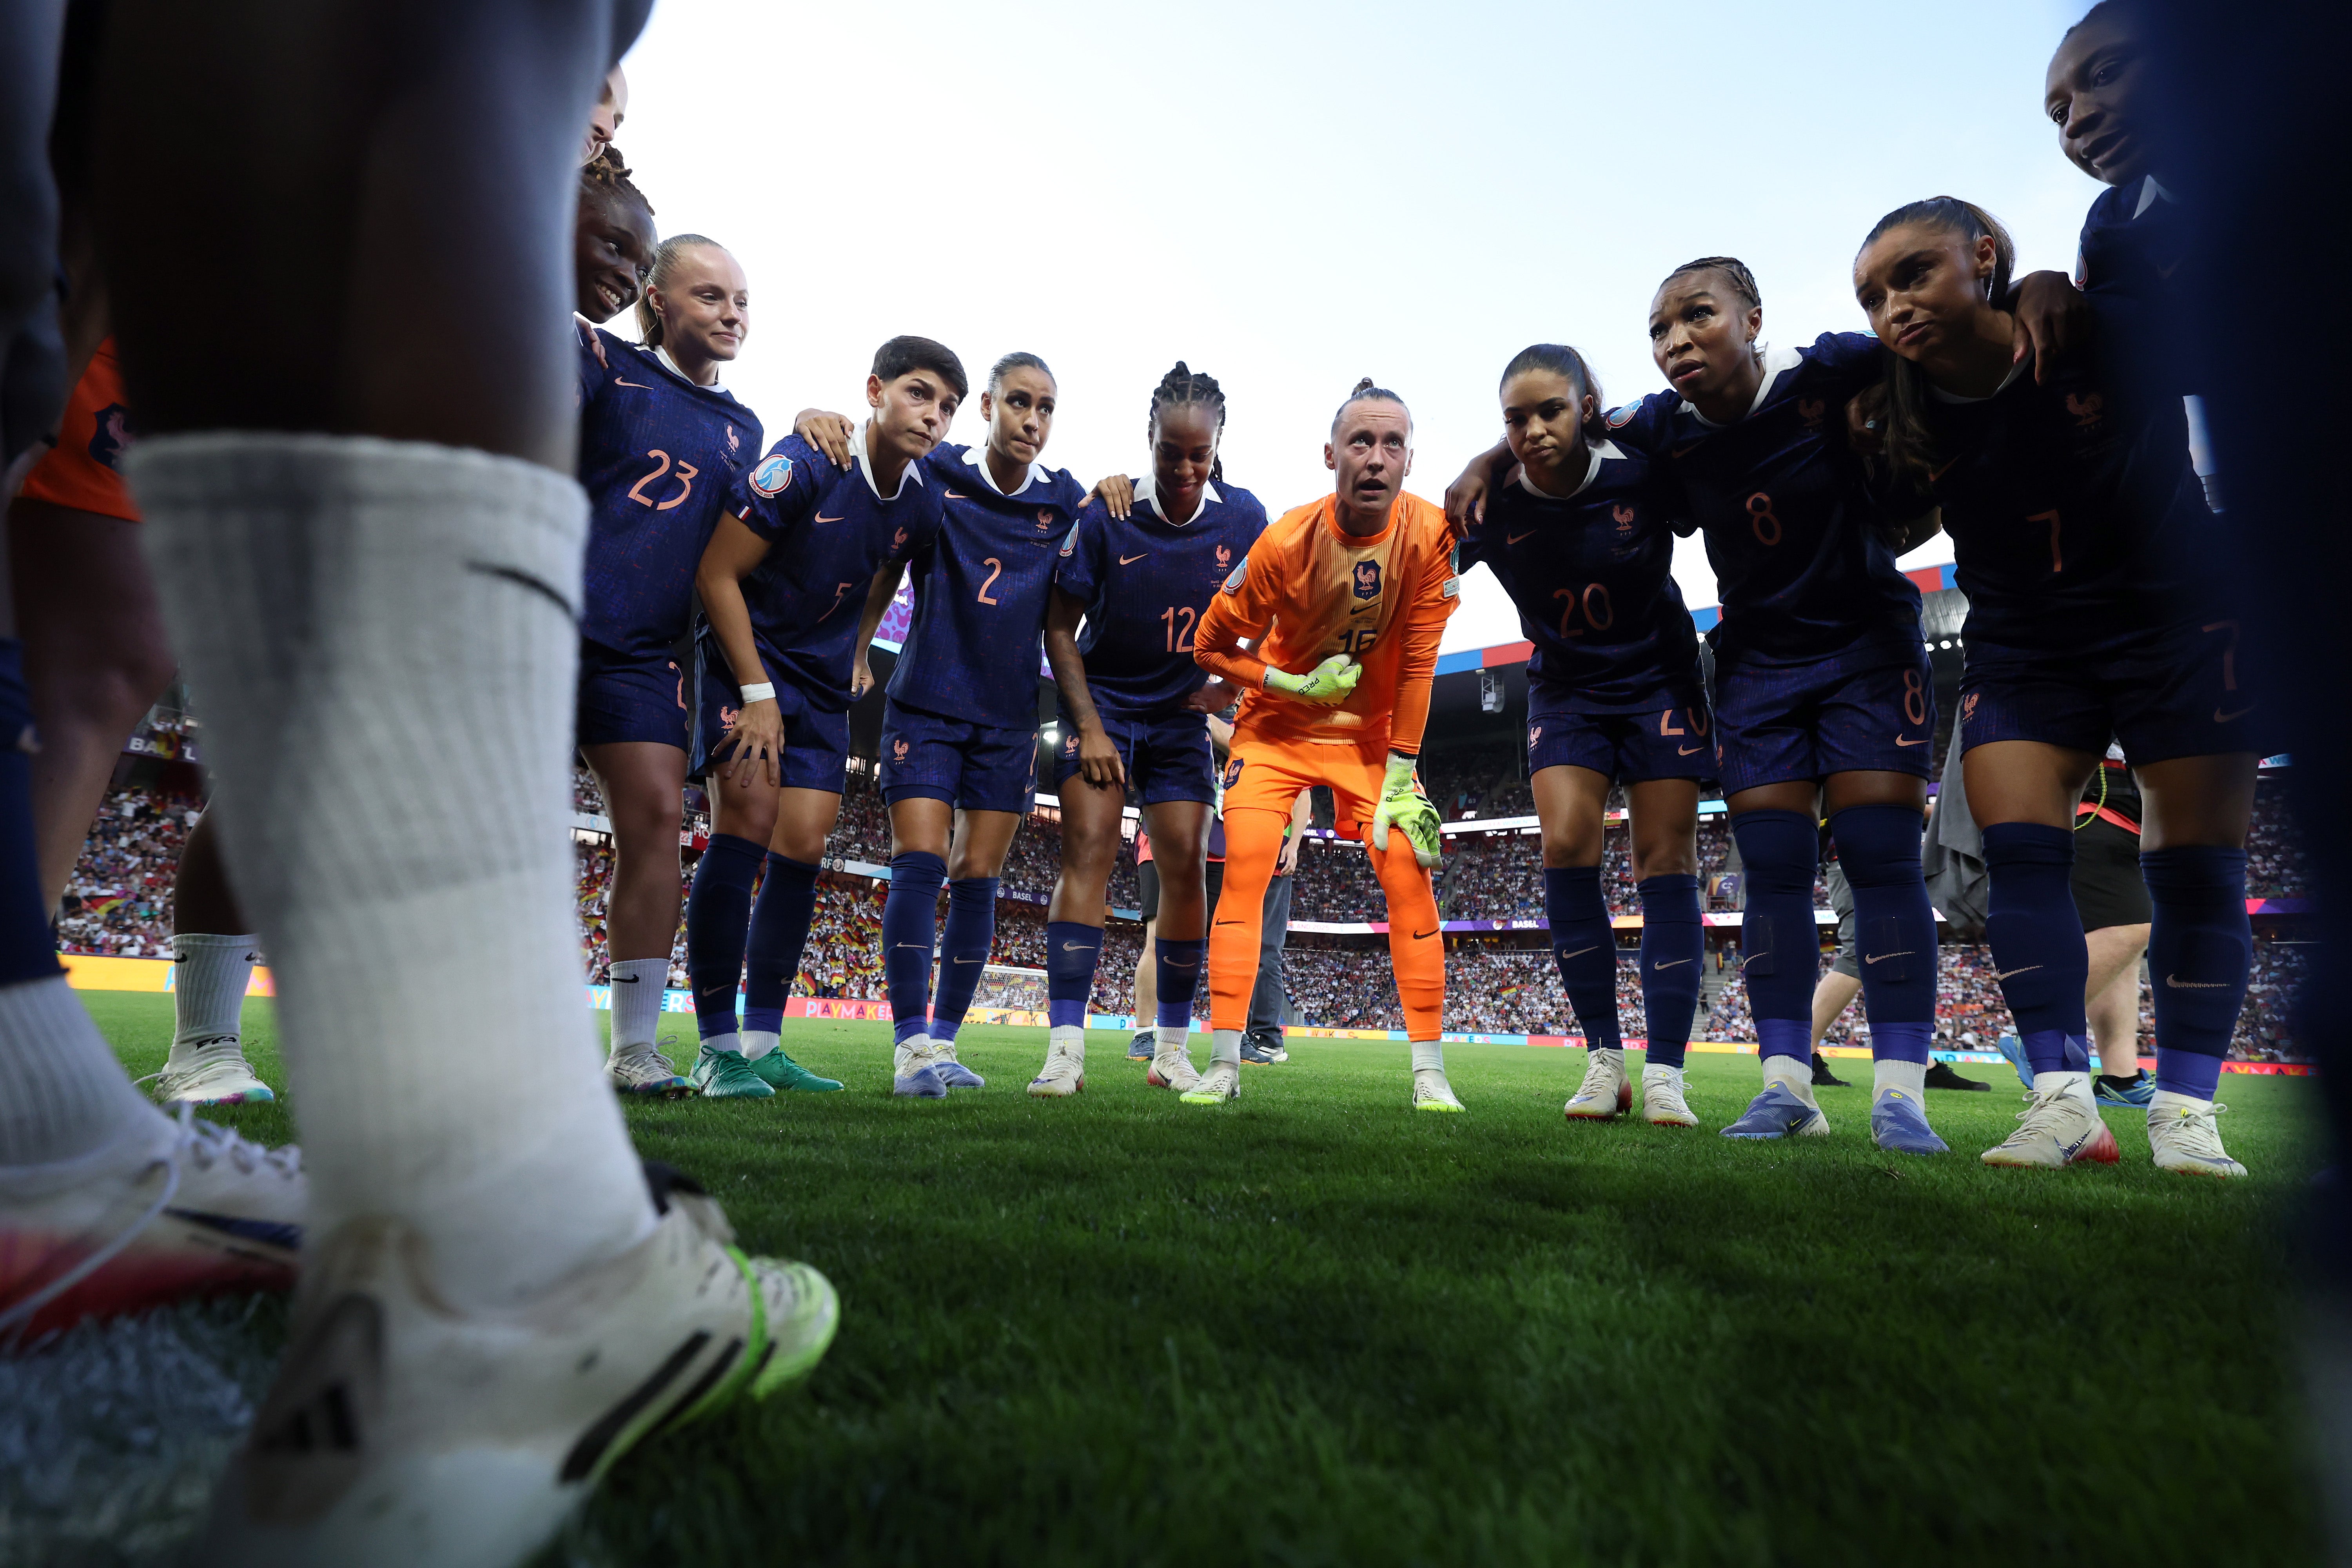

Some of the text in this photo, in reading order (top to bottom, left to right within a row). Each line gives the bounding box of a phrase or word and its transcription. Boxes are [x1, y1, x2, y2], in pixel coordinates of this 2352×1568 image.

[628, 449, 699, 510] 23
[750, 473, 763, 495] SWITZERLAND
[1746, 492, 1782, 546] 8
[2026, 509, 2062, 573] 7
[817, 583, 852, 623] 5
[977, 557, 1001, 606] 2
[1161, 607, 1196, 653] 12
[1553, 583, 1613, 639] 20
[2201, 619, 2240, 690] 7
[1298, 677, 1320, 695] PRED
[1904, 668, 1925, 725] 8
[821, 857, 833, 869] RF
[1012, 891, 1033, 902] BASEL
[1512, 920, 1539, 929] BASEL
[806, 1001, 893, 1021] PLAYMAKER
